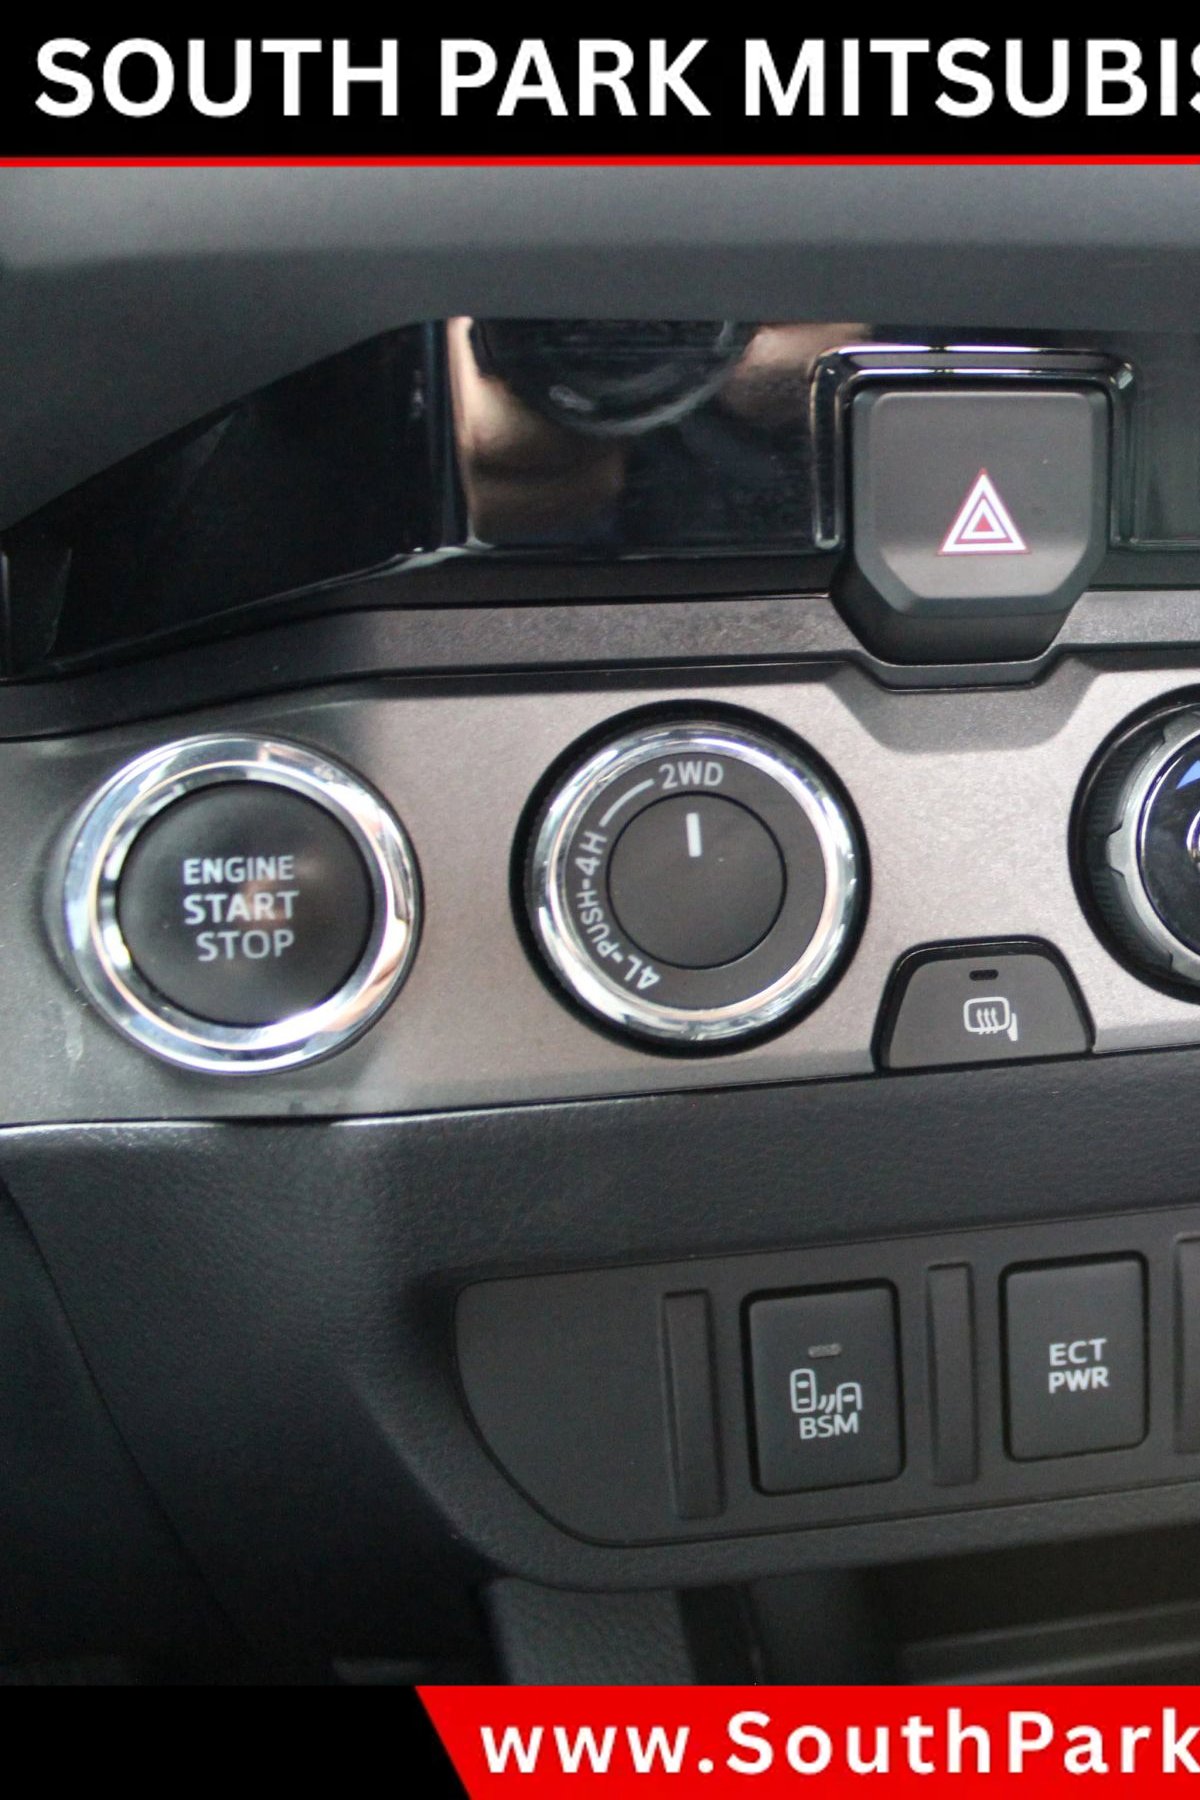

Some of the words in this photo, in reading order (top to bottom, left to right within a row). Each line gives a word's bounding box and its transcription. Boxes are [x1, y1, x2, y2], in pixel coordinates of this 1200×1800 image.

[658, 760, 724, 790] 2WD
[183, 855, 295, 885] ENGINE
[183, 890, 299, 925] START
[196, 929, 294, 962] STOP
[1048, 1337, 1107, 1367] ECT
[1048, 1366, 1110, 1394] PWR
[799, 1412, 860, 1440] BSM
